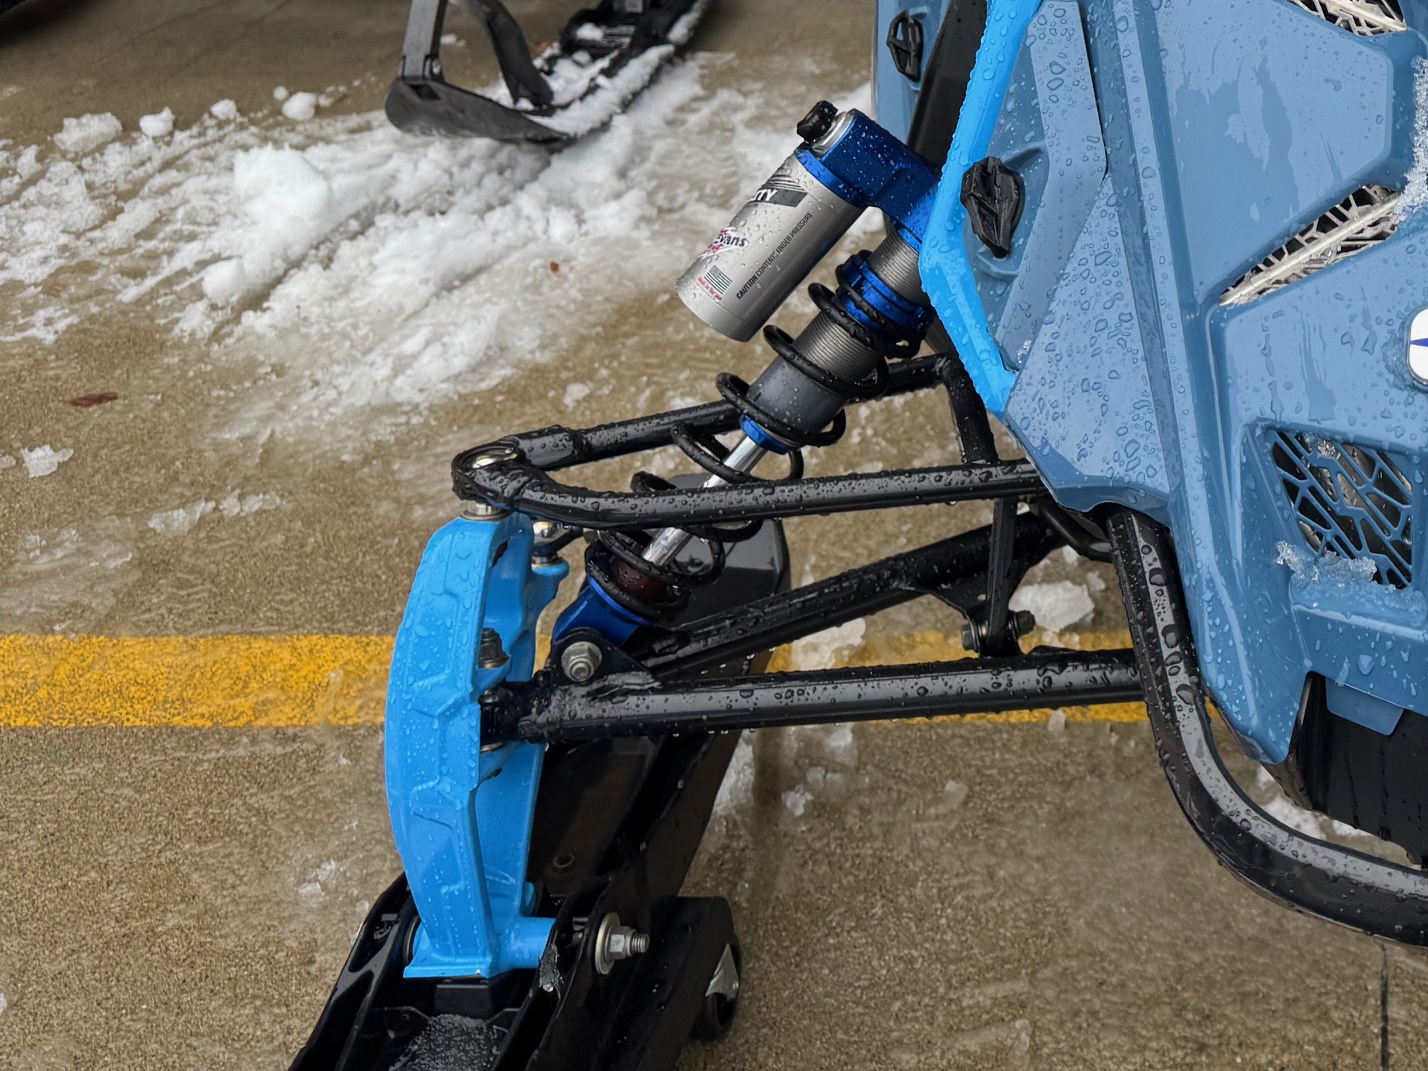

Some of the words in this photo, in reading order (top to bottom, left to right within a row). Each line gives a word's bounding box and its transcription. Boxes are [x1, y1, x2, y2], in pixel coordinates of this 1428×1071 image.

[736, 273, 758, 300] CAUTION
[756, 250, 778, 277] CONTENTS
[776, 234, 793, 256] UNDER
[789, 212, 813, 238] PRESSURE
